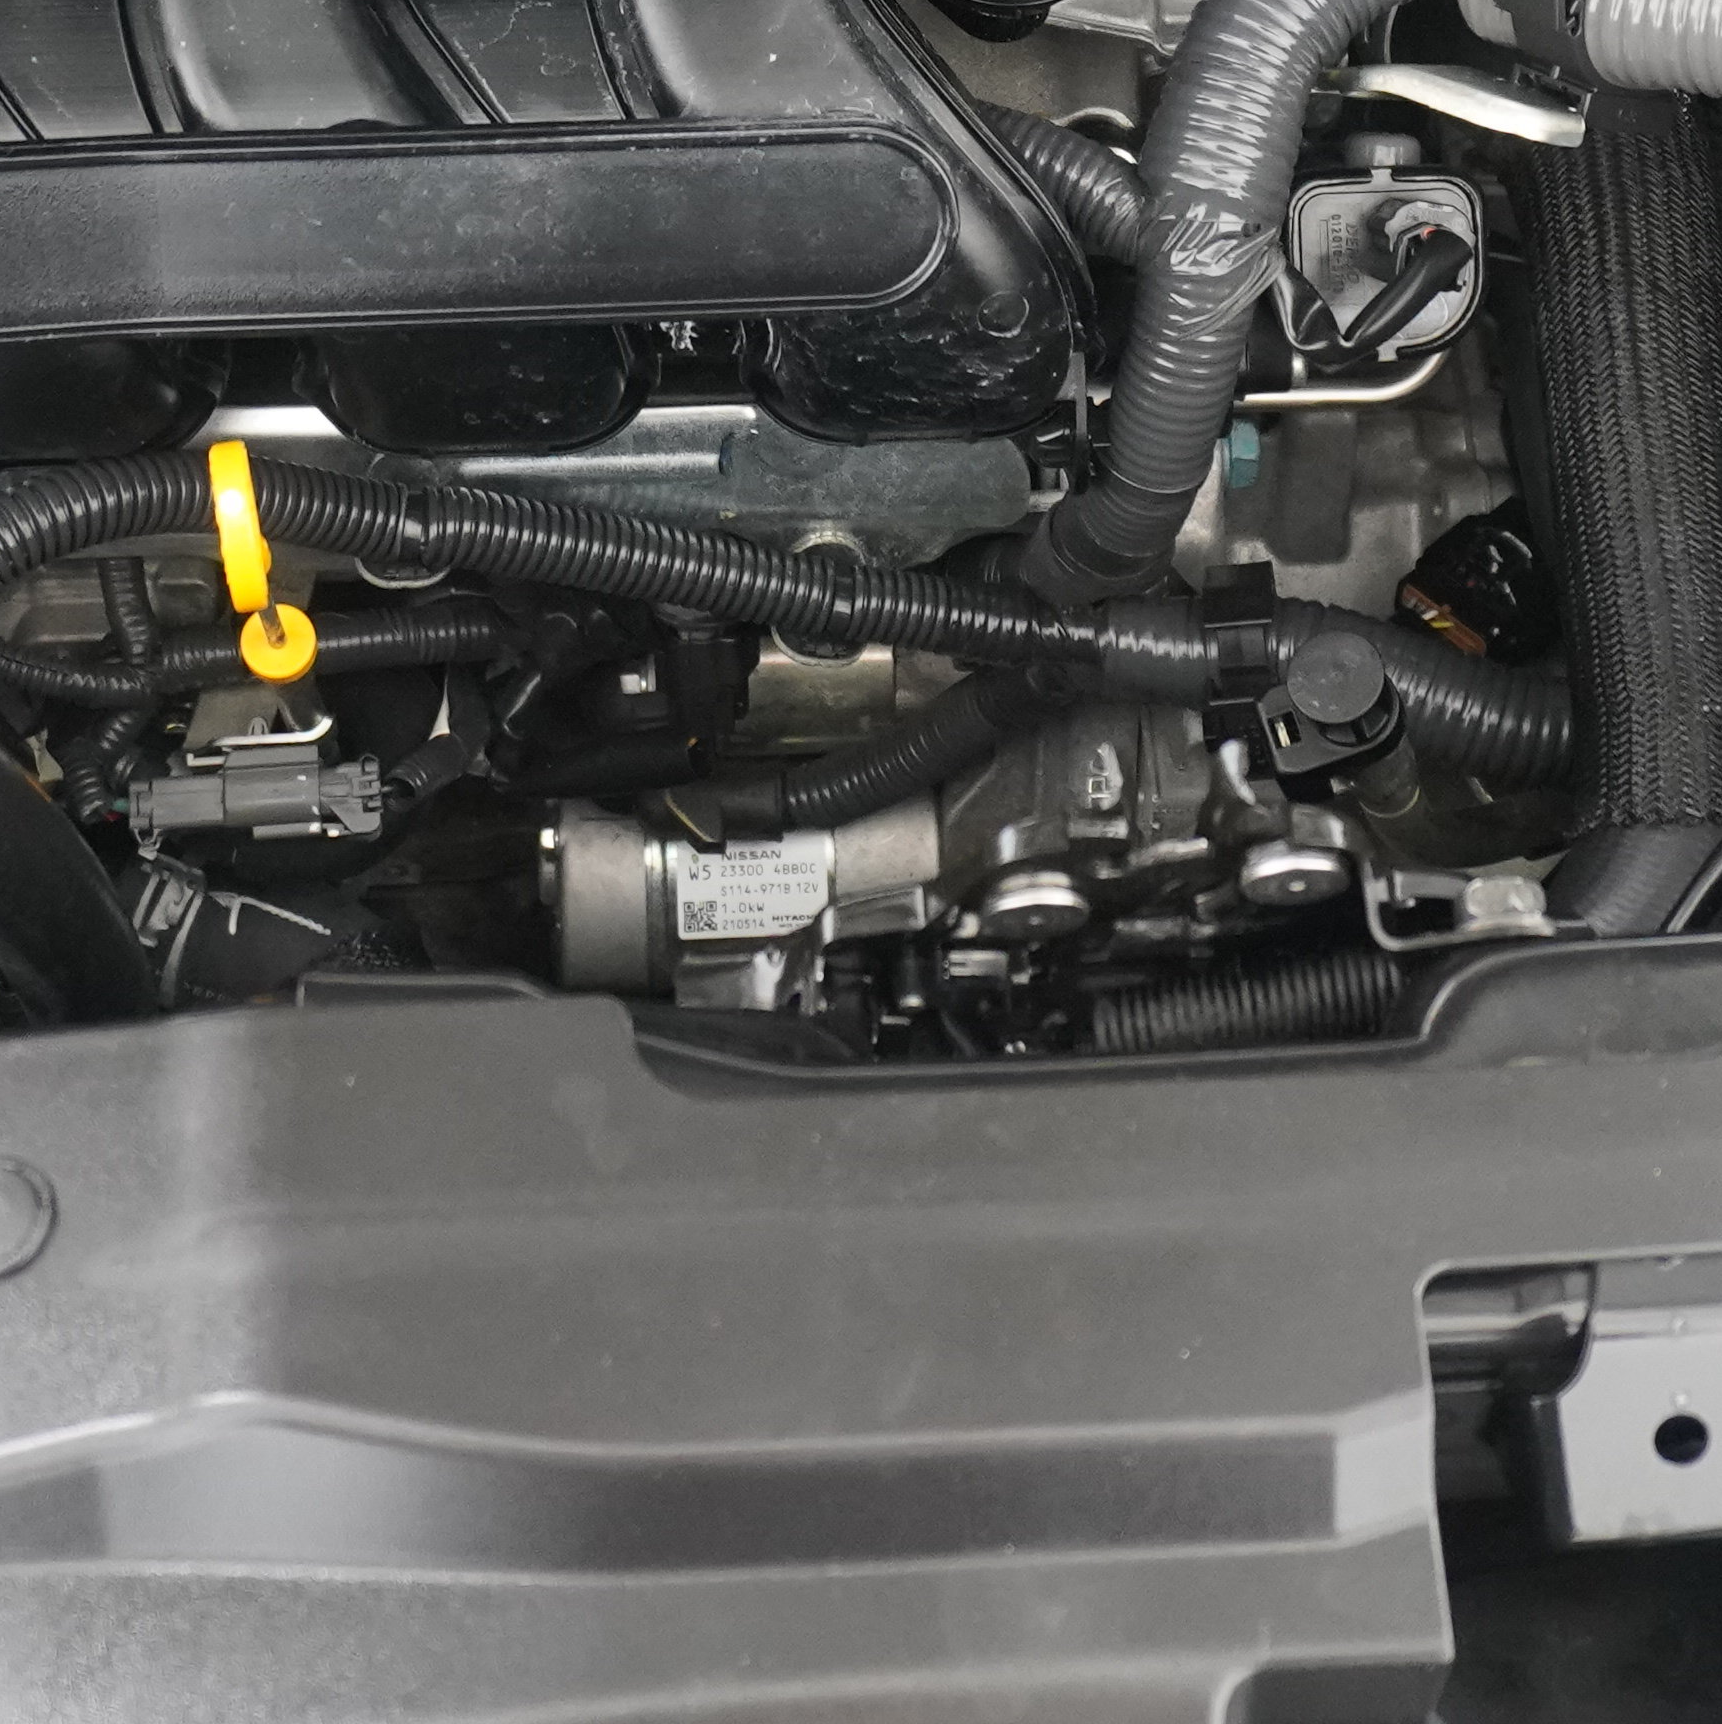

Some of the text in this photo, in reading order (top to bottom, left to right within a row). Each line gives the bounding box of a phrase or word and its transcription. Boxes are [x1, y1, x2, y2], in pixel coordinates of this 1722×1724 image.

[722, 849, 782, 861] NISSAN
[689, 864, 711, 881] W5
[720, 864, 764, 877] 23300
[797, 882, 820, 893] 12V
[723, 918, 766, 931] 210514
[772, 914, 814, 923] HITACH
